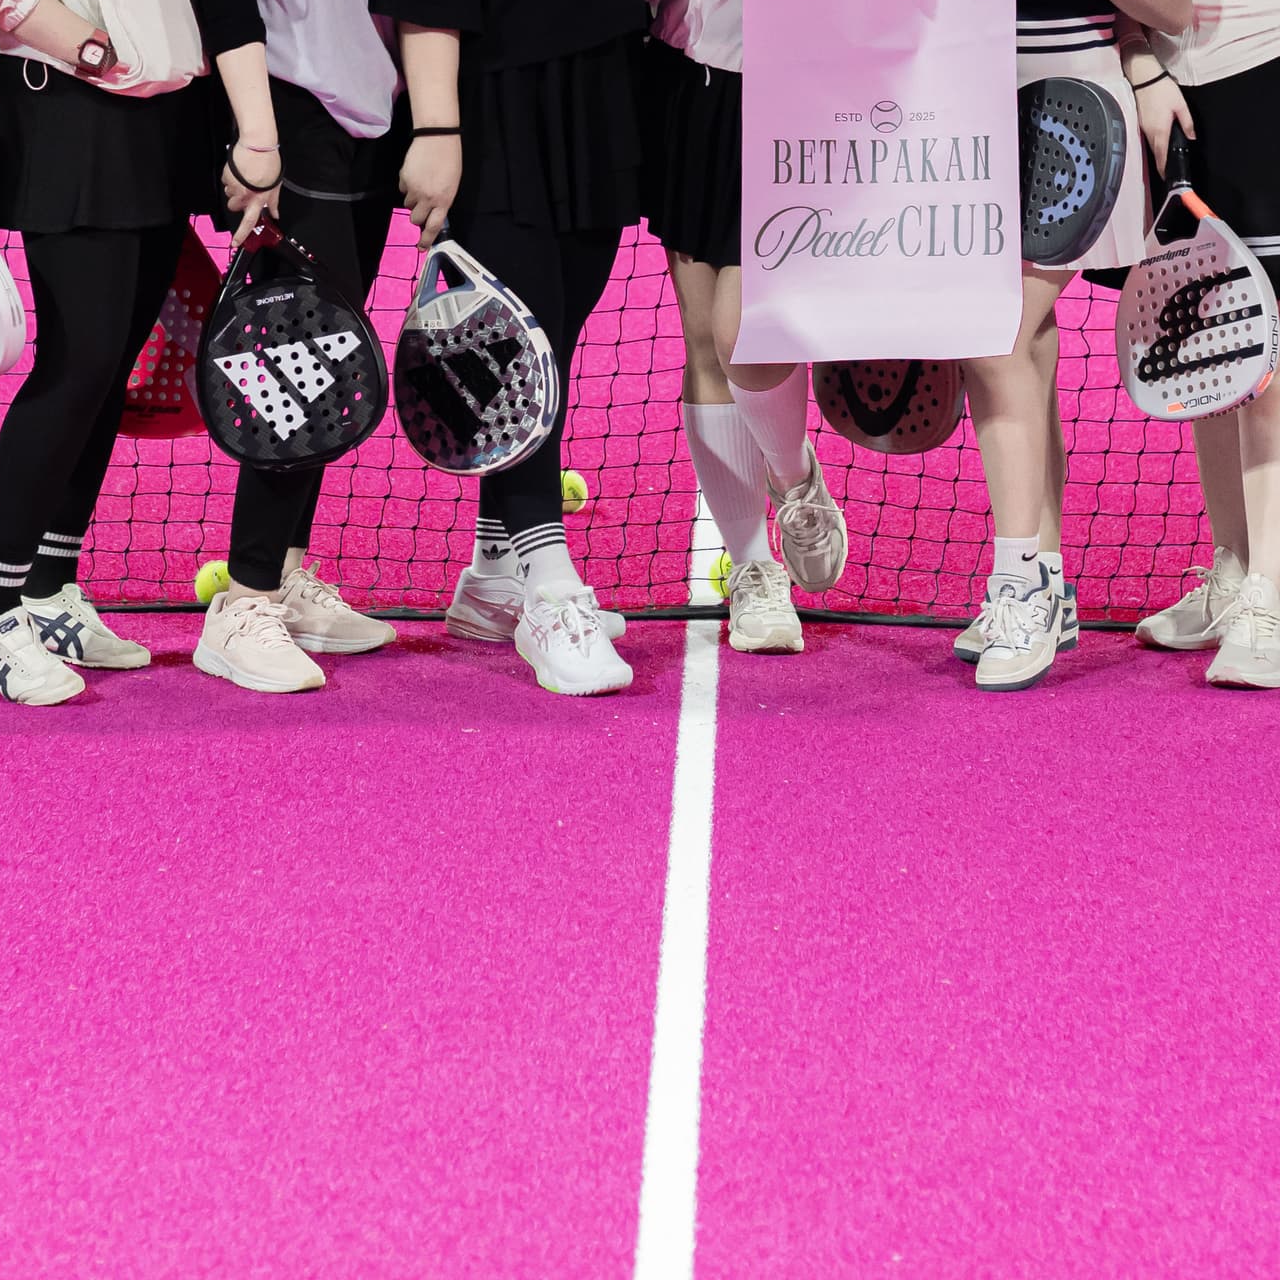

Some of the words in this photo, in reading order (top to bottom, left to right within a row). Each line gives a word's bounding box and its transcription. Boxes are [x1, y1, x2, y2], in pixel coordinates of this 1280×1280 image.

[834, 112, 864, 123] ESTD
[908, 110, 936, 122] 2025
[771, 135, 992, 185] BETAPAKAN
[753, 205, 897, 271] Padel
[897, 202, 1006, 258] CLUB
